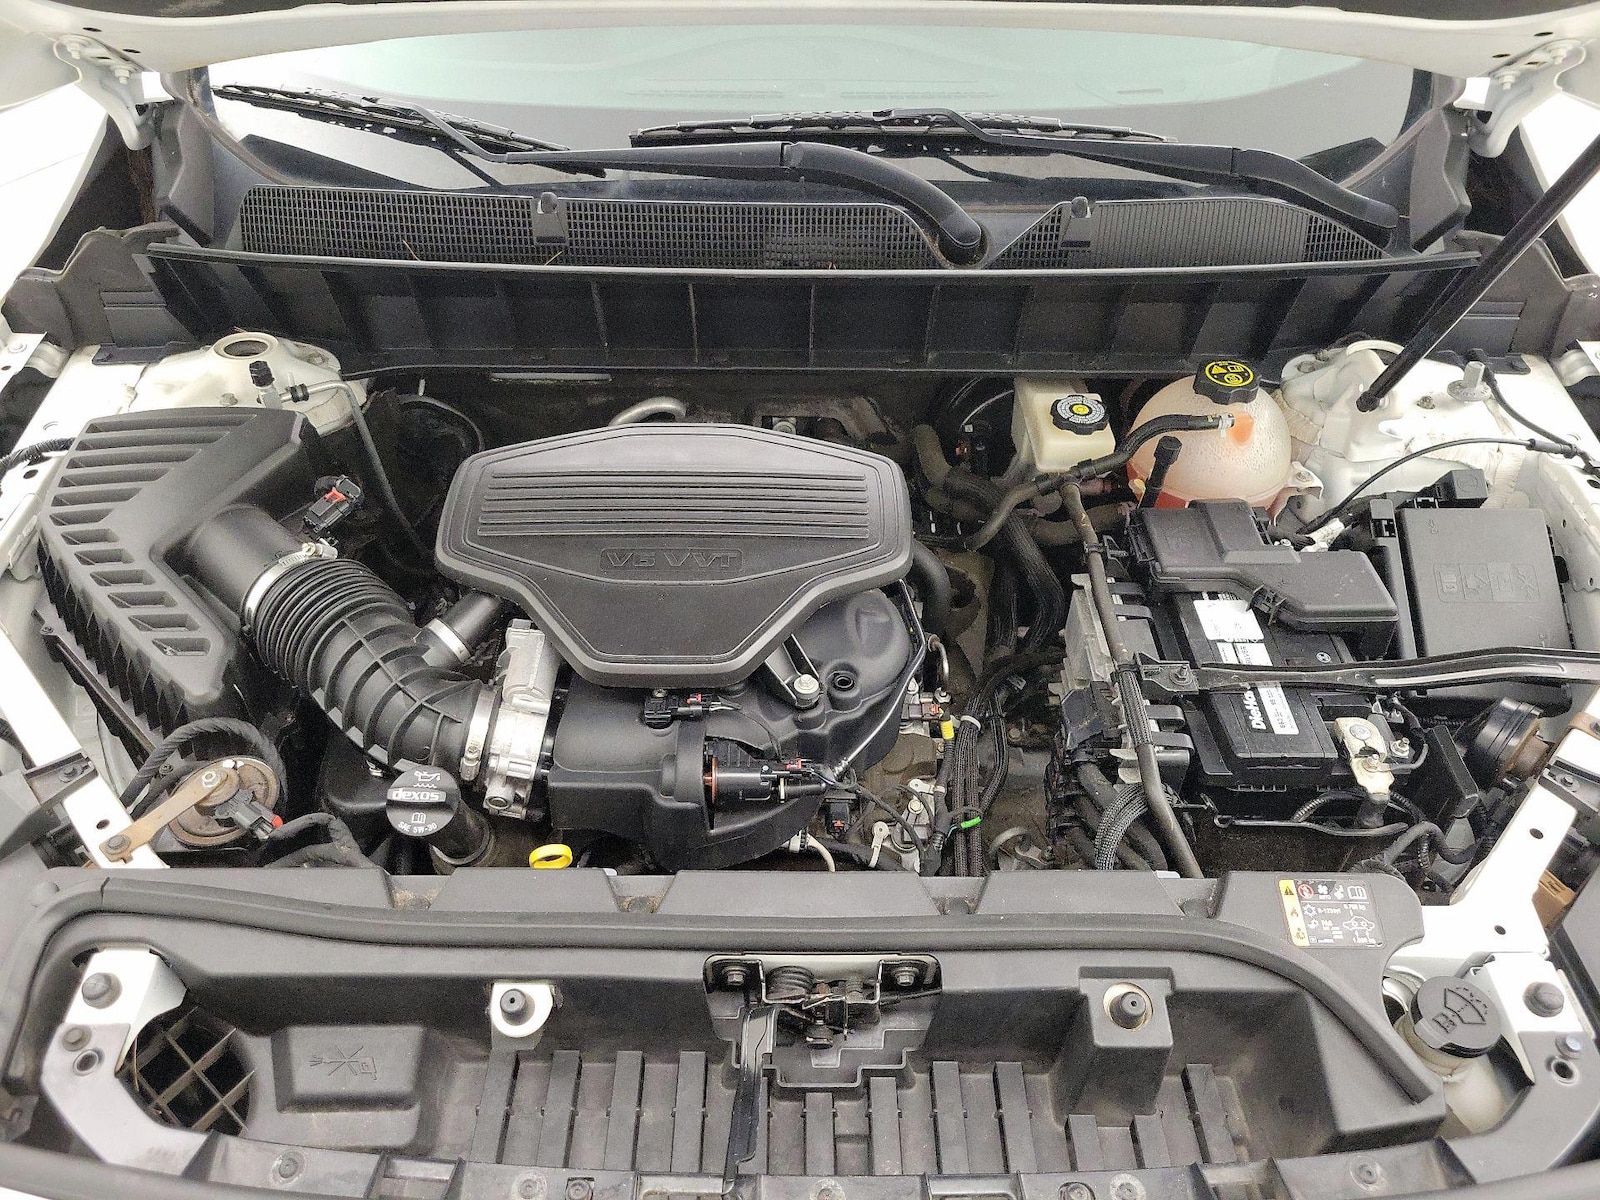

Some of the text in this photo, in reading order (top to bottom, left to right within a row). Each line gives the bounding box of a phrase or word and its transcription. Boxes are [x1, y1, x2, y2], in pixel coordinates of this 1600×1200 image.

[606, 552, 738, 568] V6 VVT
[392, 788, 440, 801] dexos
[398, 821, 437, 833] SAE 5W-30
